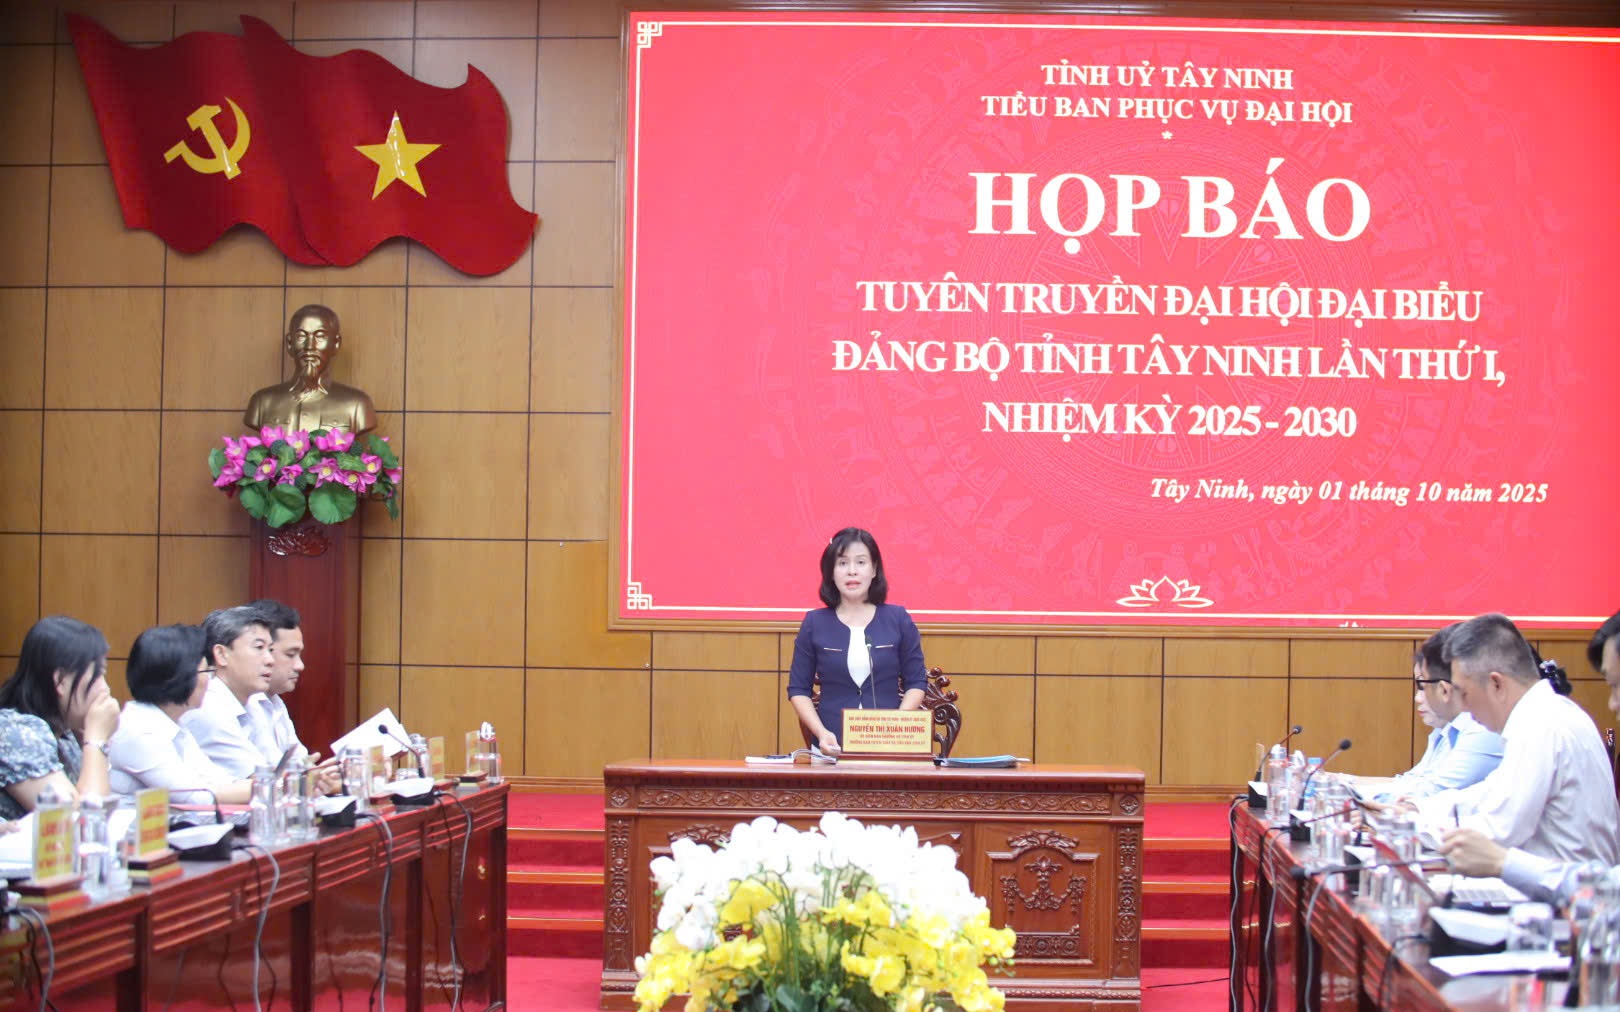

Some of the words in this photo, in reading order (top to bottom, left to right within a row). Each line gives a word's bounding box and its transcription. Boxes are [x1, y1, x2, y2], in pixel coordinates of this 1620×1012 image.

[1041, 59, 1110, 86] TỈNH
[1116, 60, 1155, 87] UỶ
[1161, 61, 1218, 88] TÂY
[1223, 68, 1294, 90] NINH
[981, 91, 1048, 116] TIỂU
[1054, 97, 1111, 117] BAN
[1117, 98, 1194, 124] PHỤC
[1200, 100, 1239, 125] VỤ
[1245, 100, 1295, 126] ĐẠI
[1301, 99, 1353, 128] HỘI
[968, 172, 1161, 255] HỌP
[1181, 157, 1371, 242] BÁO
[856, 271, 990, 312] TUYÊN
[996, 275, 1159, 315] TRUYỀN
[1163, 284, 1233, 325] ĐẠI
[1239, 282, 1314, 327] HỘI
[1317, 287, 1387, 328] ĐẠI
[1392, 281, 1483, 322] BIỂU
[832, 330, 948, 372] ĐẢNG
[952, 336, 1010, 381] BỘ
[1014, 332, 1113, 374] TỈNH
[1117, 333, 1200, 375] TÂY
[1203, 345, 1303, 377] NINH
[1307, 338, 1388, 379] LẦN
[1392, 339, 1481, 380] THỨ
[1483, 350, 1505, 387] I,
[982, 397, 1118, 442] NHIỆM
[1122, 394, 1183, 434] KỲ
[1188, 405, 1262, 436] 2025
[1284, 406, 1357, 437] 2030
[1151, 478, 1190, 503] Tây
[1194, 478, 1255, 502] Ninh,
[1261, 480, 1313, 504] ngày
[1319, 481, 1342, 500] 01
[1349, 480, 1410, 506] tháng
[1416, 482, 1442, 501] 10
[1446, 483, 1492, 502] năm
[1498, 483, 1548, 502] 2025
